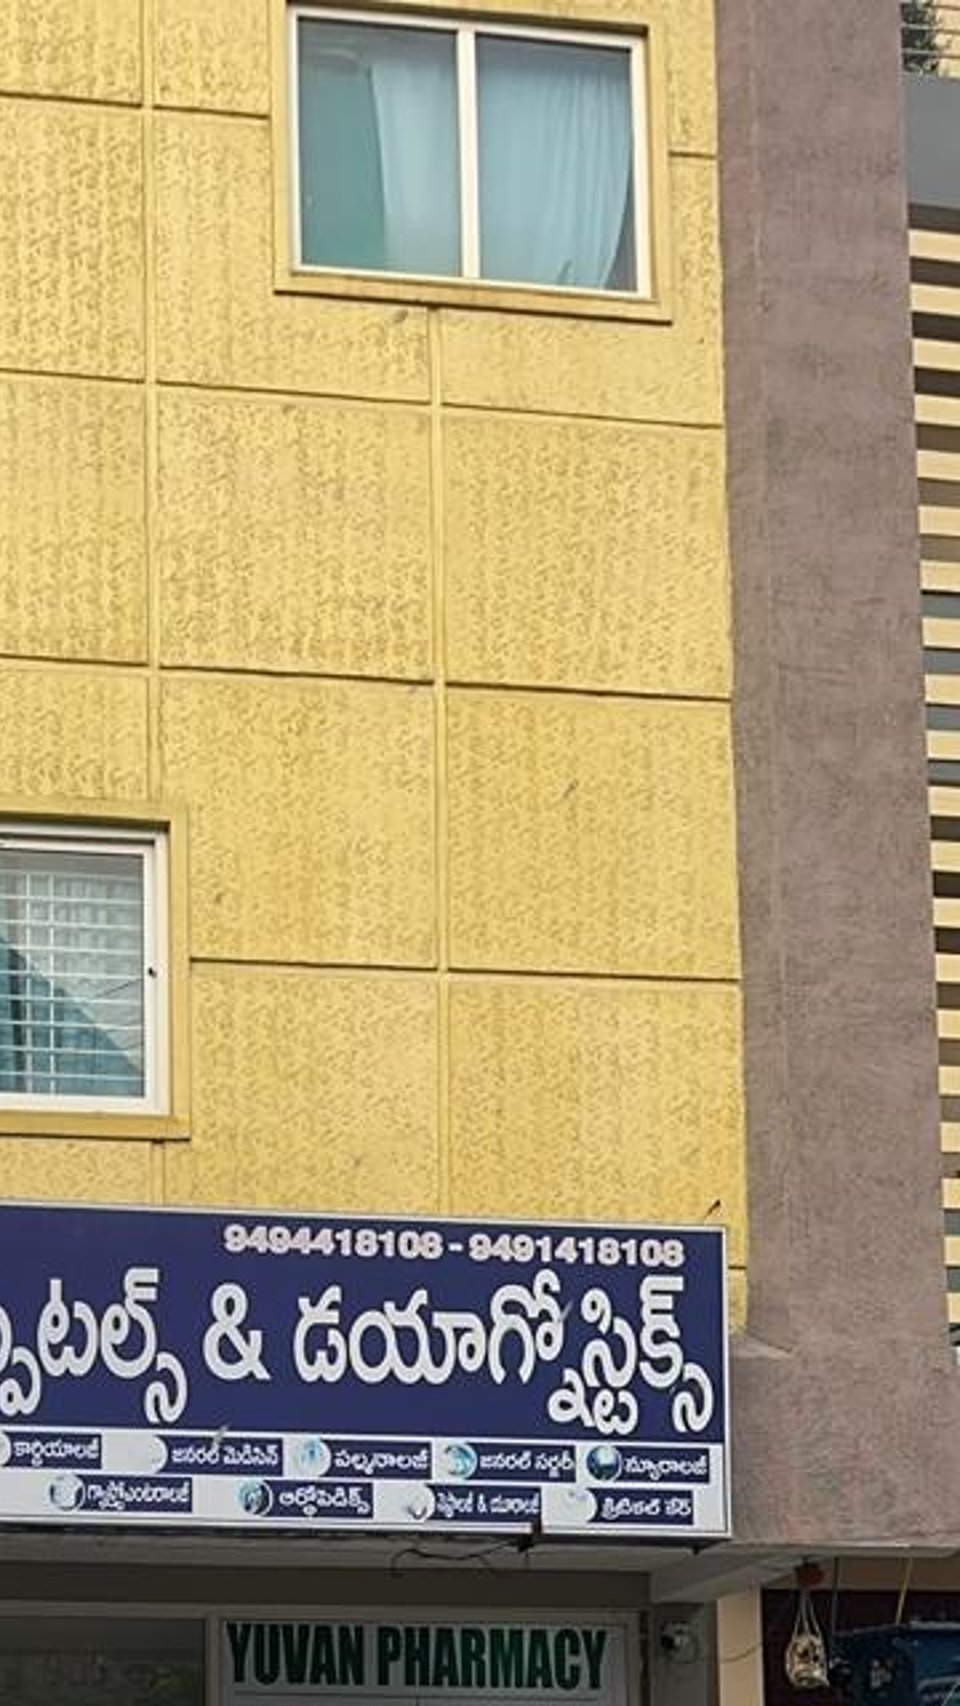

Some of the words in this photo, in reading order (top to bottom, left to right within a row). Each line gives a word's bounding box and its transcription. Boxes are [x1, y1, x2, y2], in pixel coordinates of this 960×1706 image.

[224, 1225, 442, 1258] 9494418108
[469, 1234, 685, 1267] 9491418108
[204, 1284, 271, 1380] &
[293, 1267, 713, 1433] డయాగ్నోస్టిక్స్
[226, 1622, 364, 1687] YUVAN
[377, 1626, 608, 1691] PHARMACY
